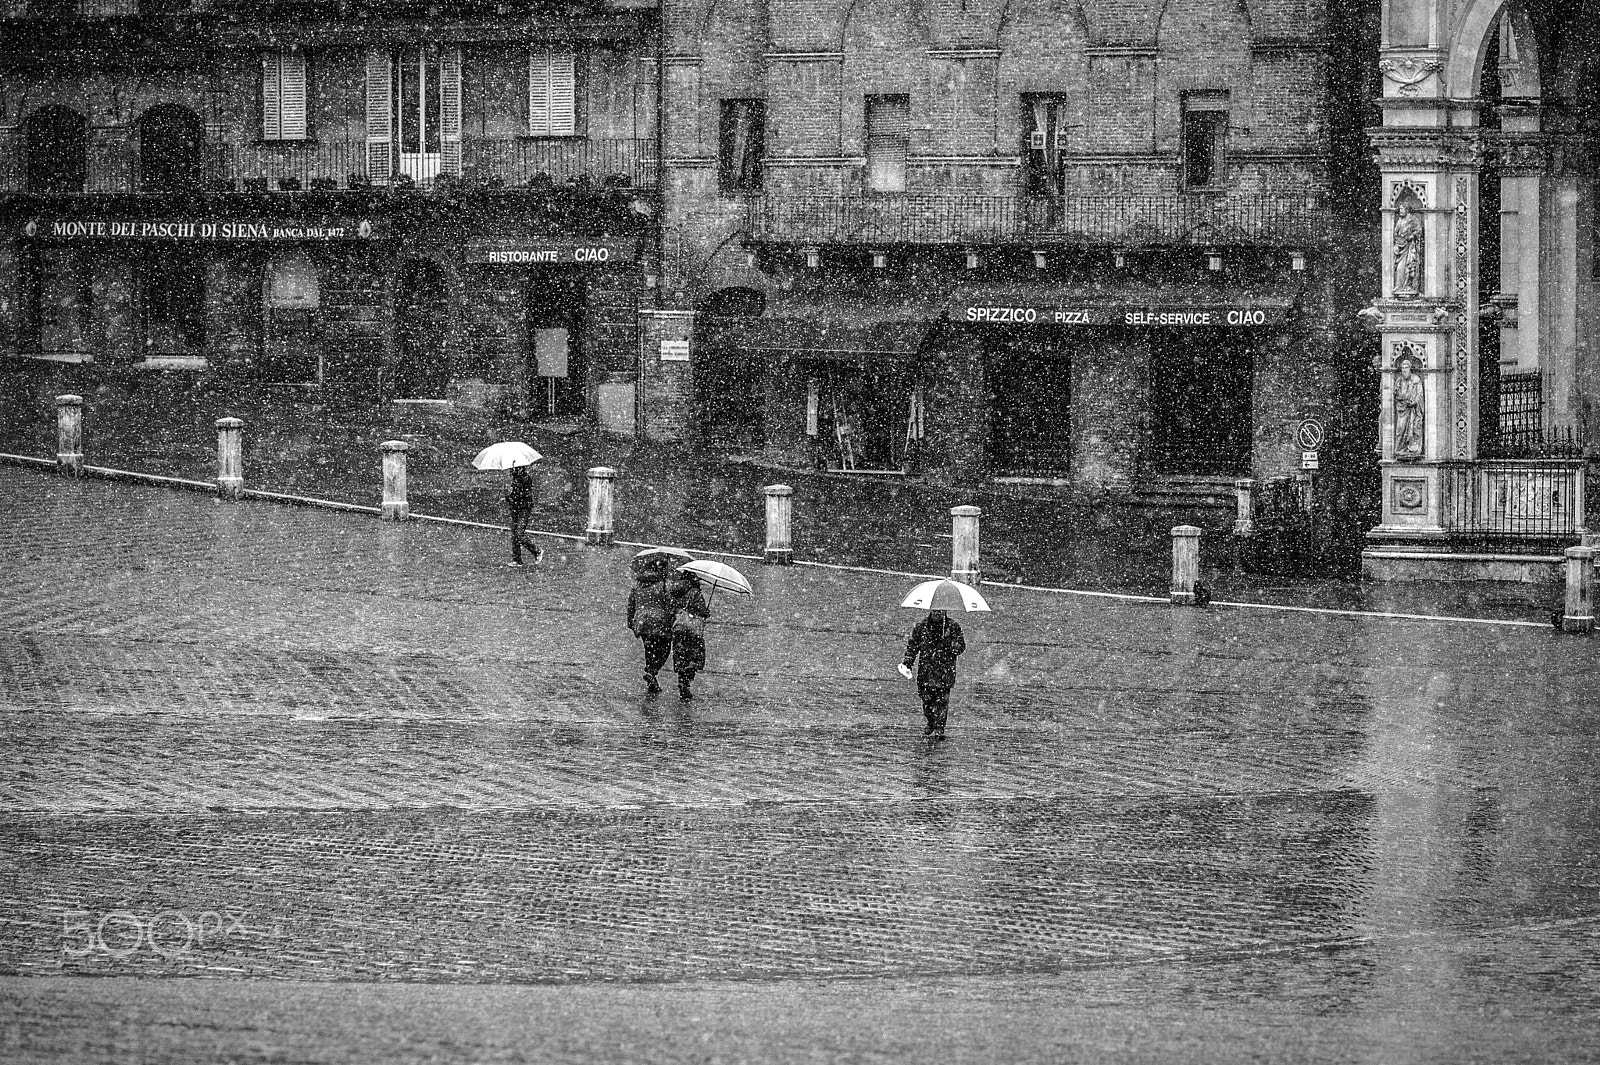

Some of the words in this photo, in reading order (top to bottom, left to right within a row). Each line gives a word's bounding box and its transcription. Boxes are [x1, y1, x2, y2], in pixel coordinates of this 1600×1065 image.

[53, 221, 106, 236] MONTE
[111, 222, 136, 236] DEI
[141, 222, 195, 237] PASCHI
[201, 223, 217, 238] DI
[221, 223, 268, 238] SIENA
[273, 227, 304, 238] BANCA
[306, 227, 325, 238] DAL
[327, 227, 344, 238] 1472
[489, 251, 558, 262] RISTORANTE
[575, 248, 609, 261] CIAO
[966, 307, 1037, 322] SPIZZICO
[1055, 312, 1090, 323] PIZZA
[1124, 312, 1210, 325] SELF-SERVICE
[1227, 310, 1265, 325] CIAO
